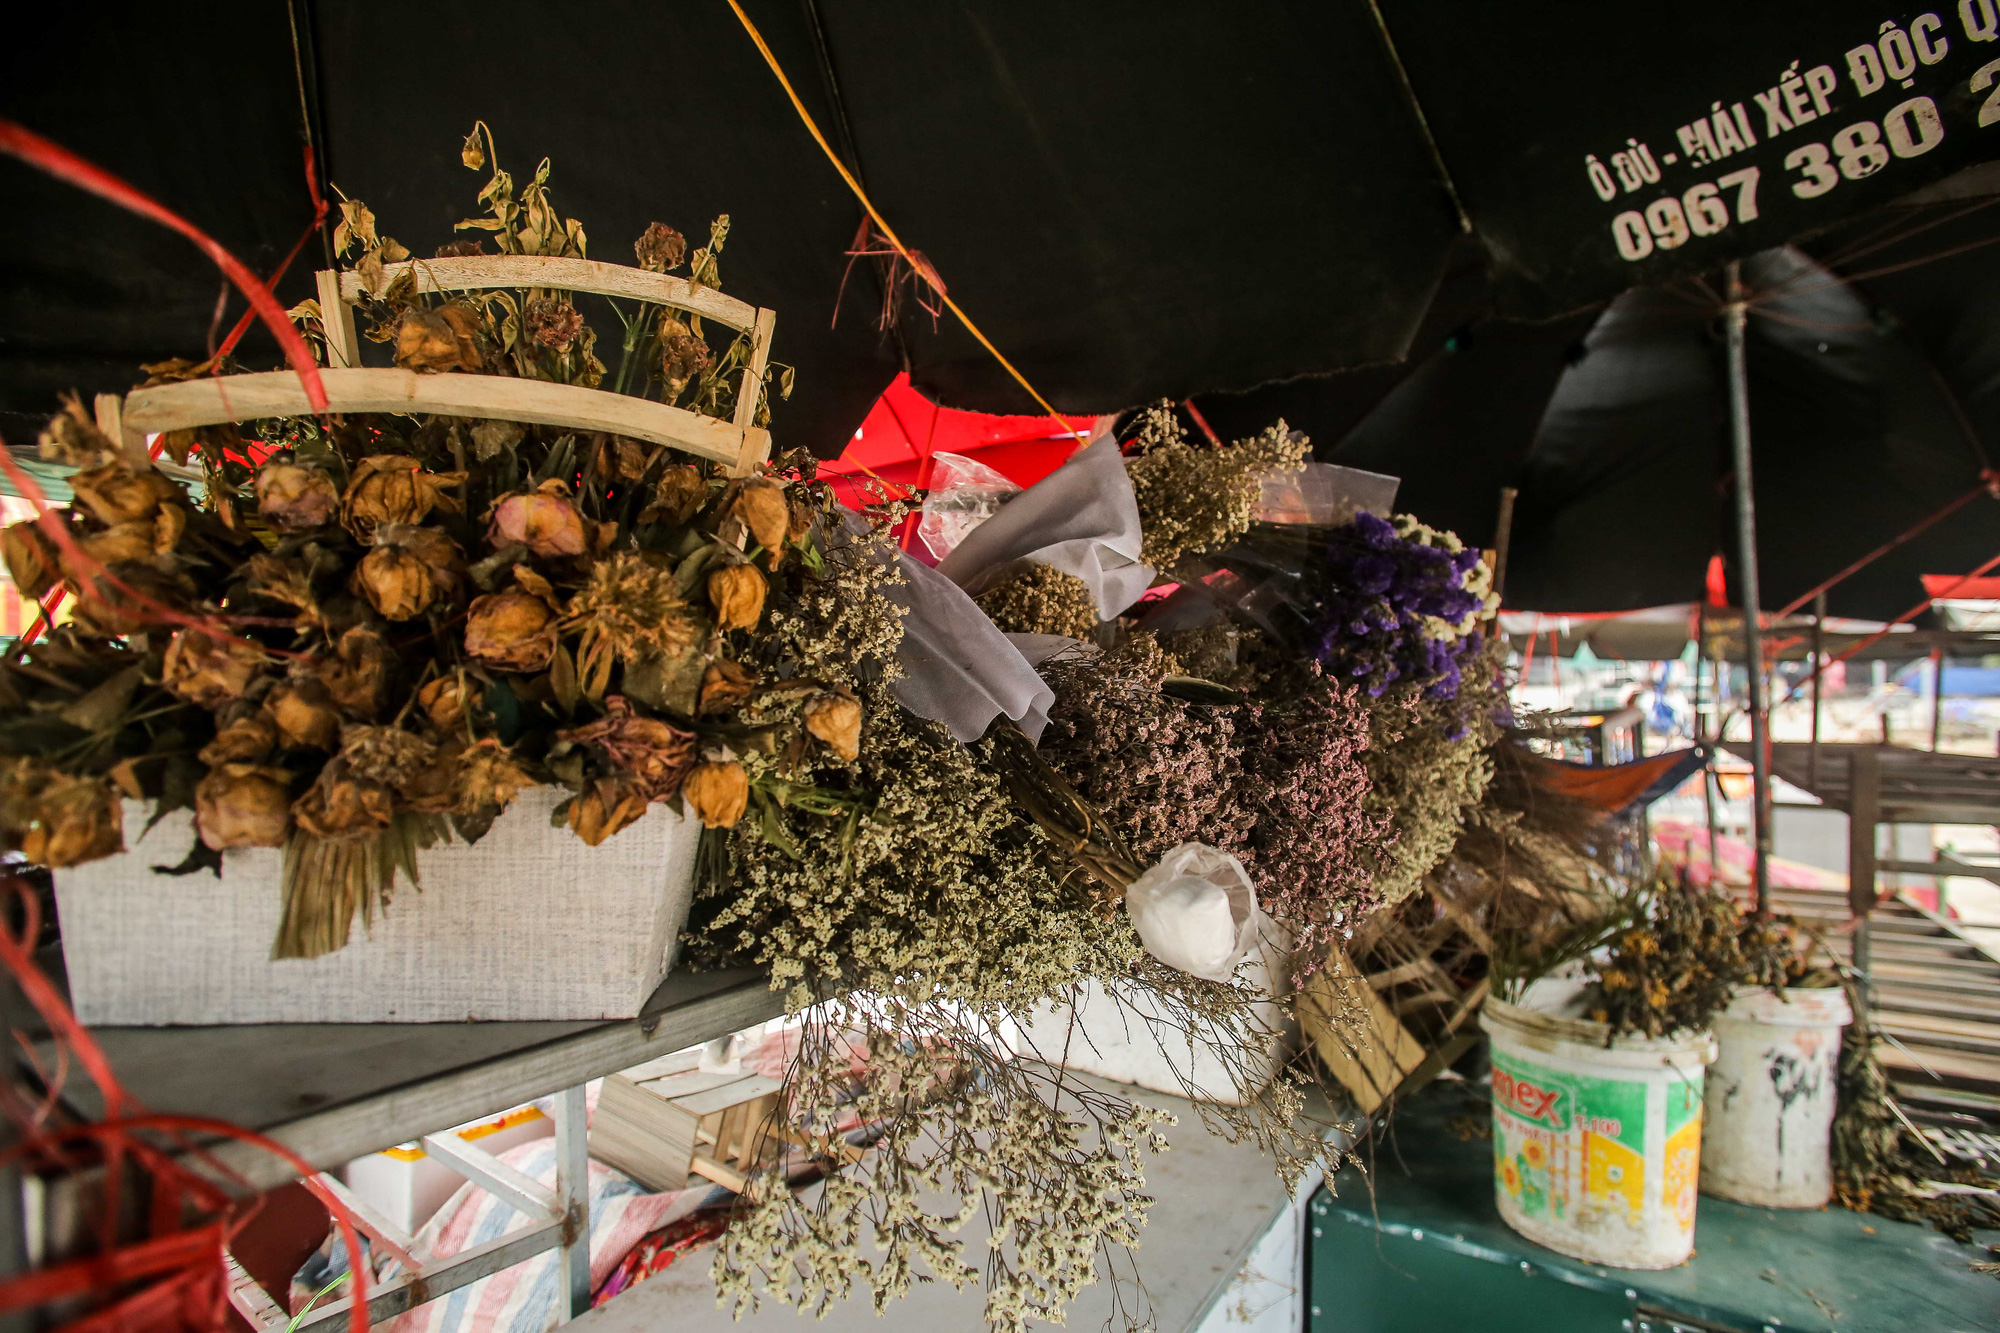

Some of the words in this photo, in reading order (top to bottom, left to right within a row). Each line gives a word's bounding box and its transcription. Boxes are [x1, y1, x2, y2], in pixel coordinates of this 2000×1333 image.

[1585, 154, 1617, 202] Ô
[1610, 138, 1661, 193] ĐÙ
[1675, 100, 1757, 169] MÁI
[1753, 59, 1837, 139] XẾP
[1844, 12, 1949, 98] ĐỘC
[1957, 0, 2000, 43] Q
[1611, 166, 1760, 262] 0967
[1783, 96, 1944, 199] 380
